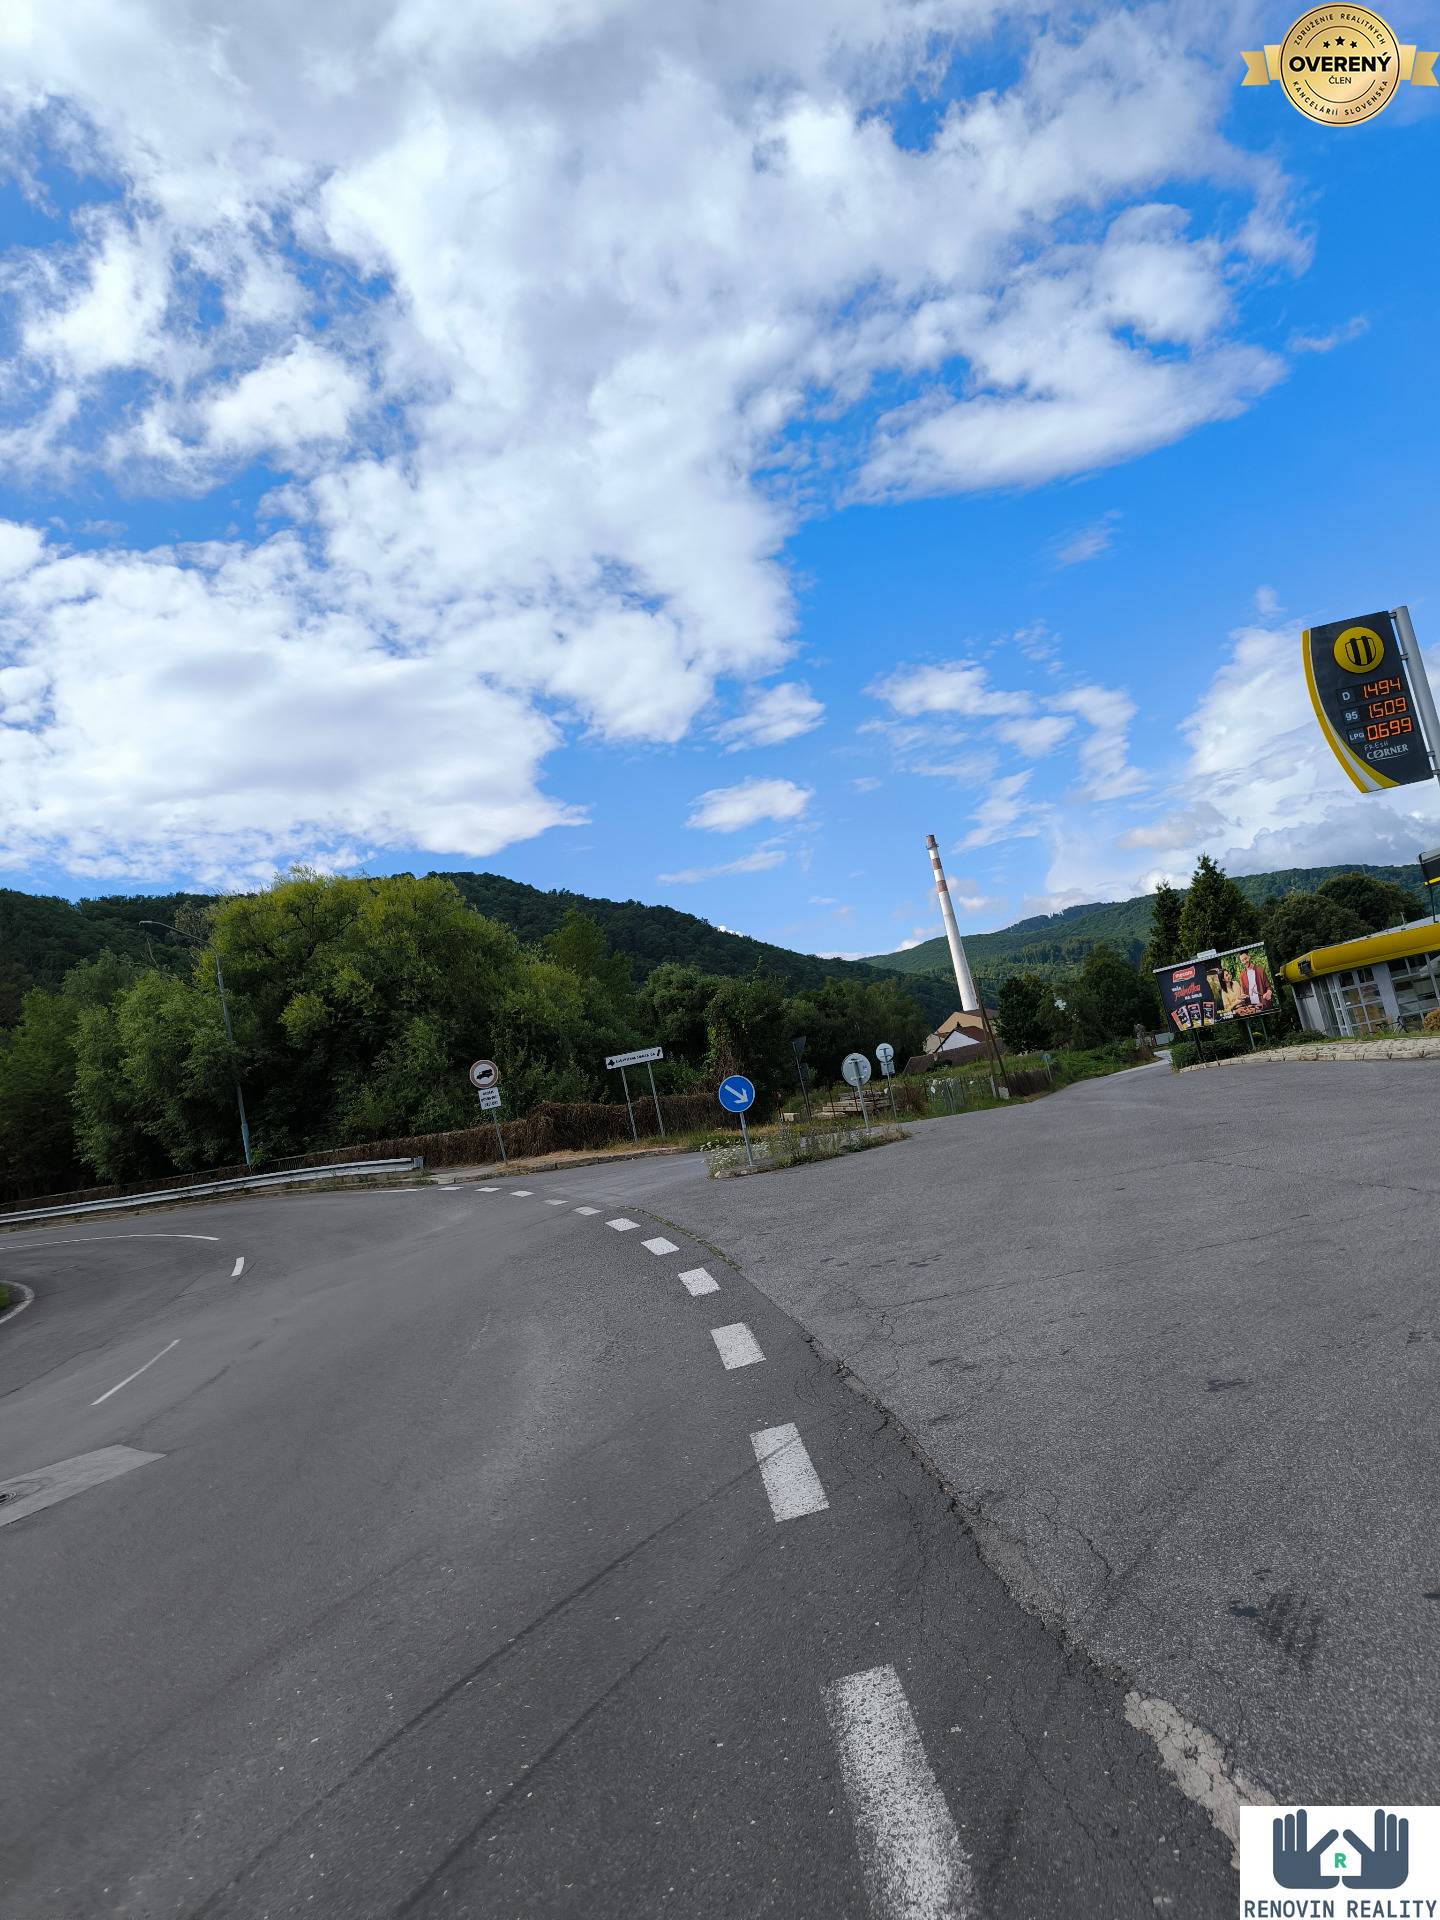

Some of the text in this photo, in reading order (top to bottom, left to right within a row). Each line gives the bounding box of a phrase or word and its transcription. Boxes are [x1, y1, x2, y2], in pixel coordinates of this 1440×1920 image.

[1342, 691, 1350, 701] D
[1345, 711, 1358, 721] 95
[1349, 732, 1364, 741] LPG
[1366, 743, 1409, 760] CORNER
